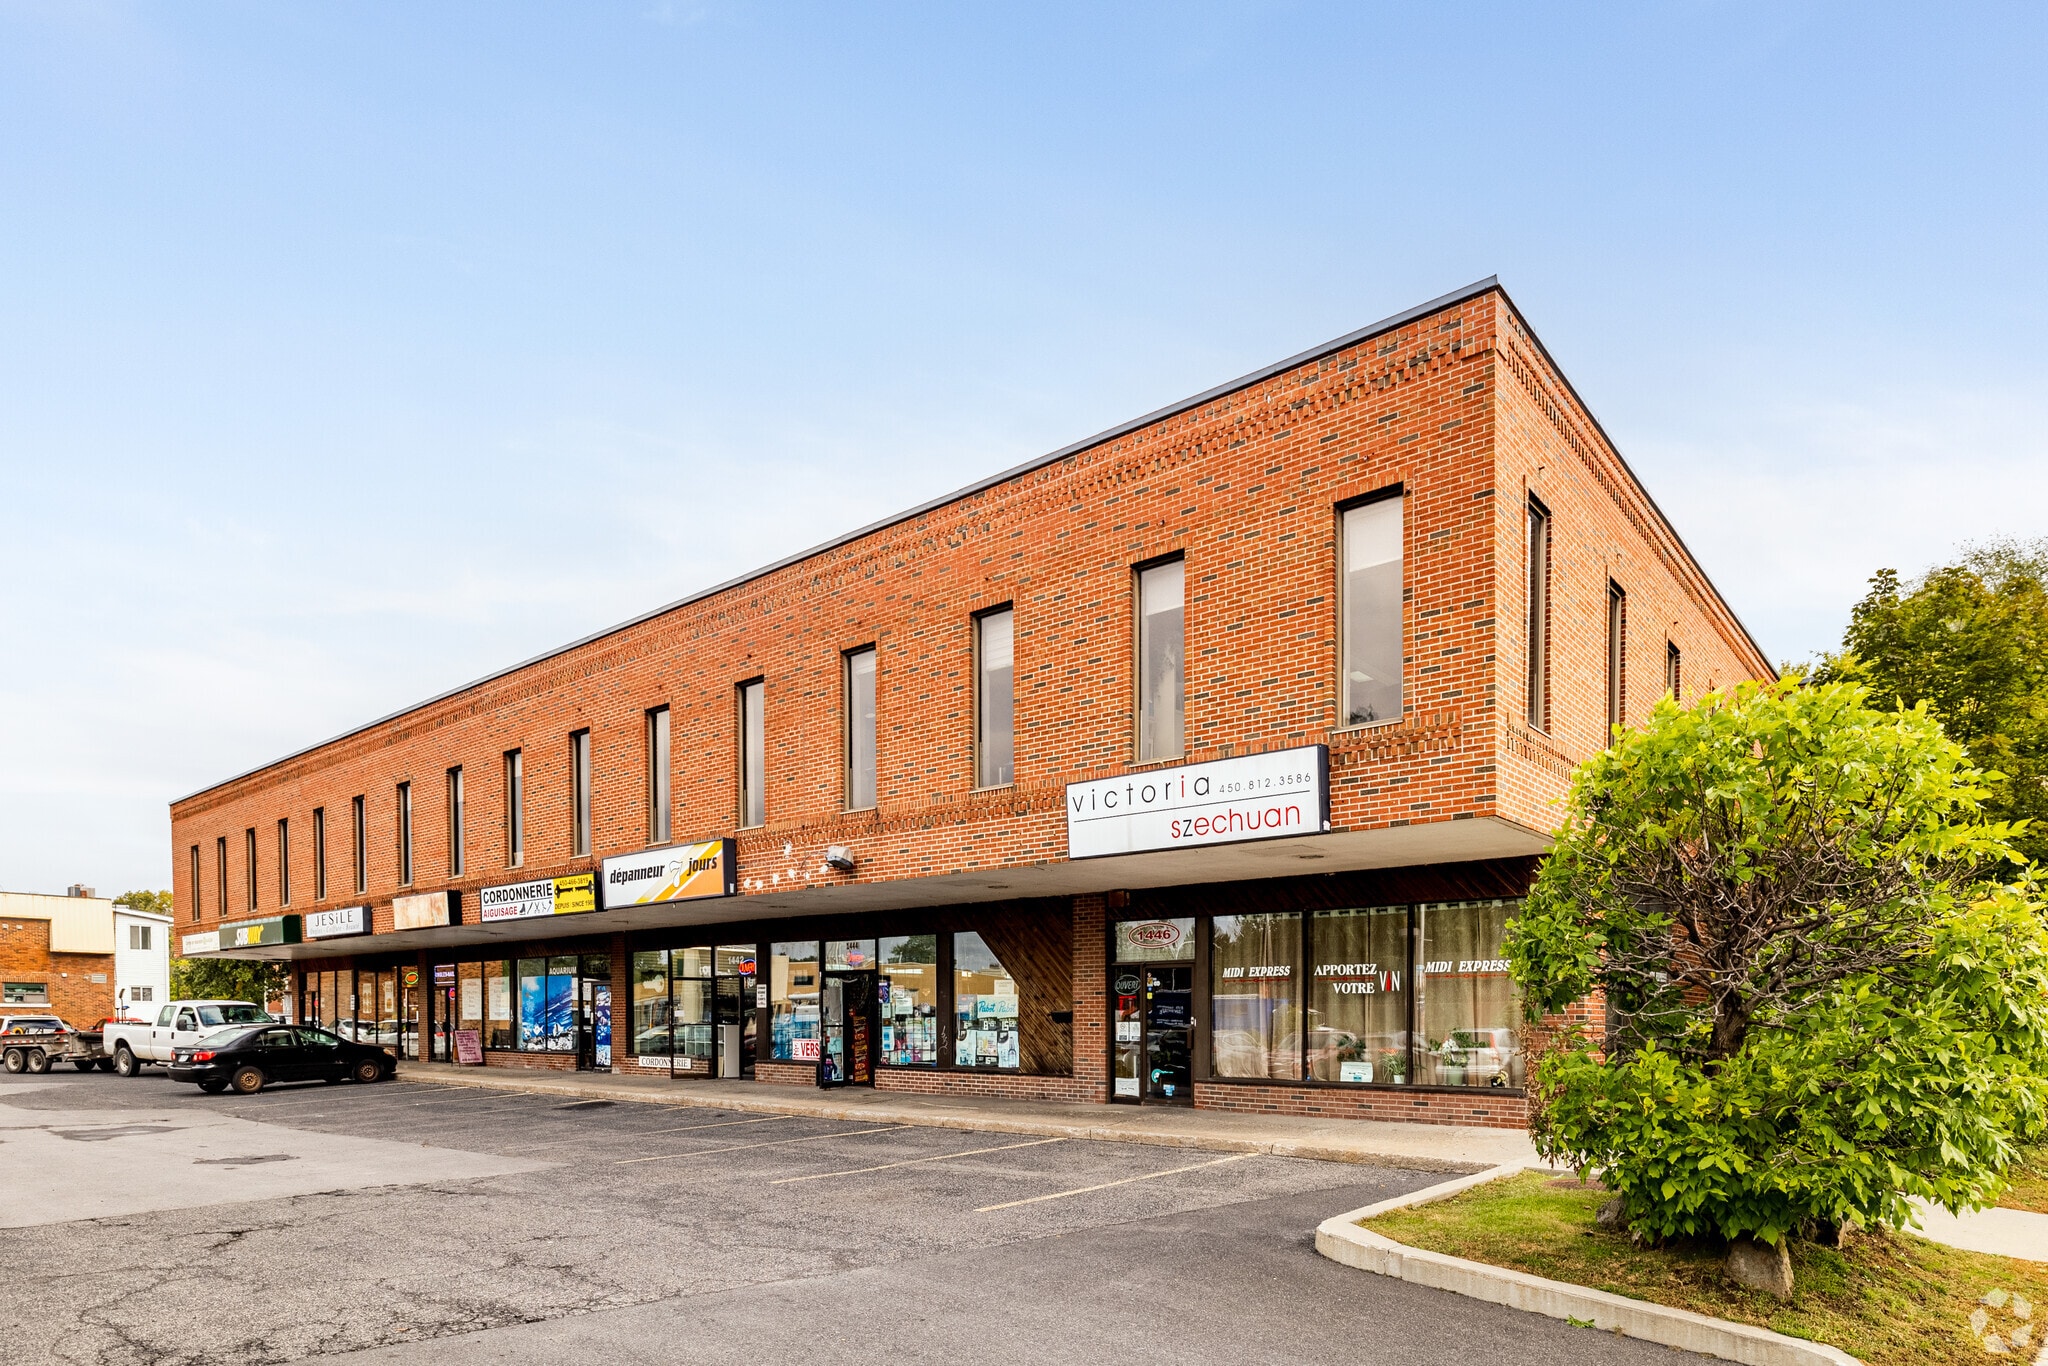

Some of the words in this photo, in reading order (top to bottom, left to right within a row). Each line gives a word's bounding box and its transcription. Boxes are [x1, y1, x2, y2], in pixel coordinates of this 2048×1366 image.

[1072, 775, 1210, 812] victoria
[1219, 772, 1312, 794] 450.812.3586
[1171, 804, 1301, 839] szechuan
[609, 864, 665, 885] dépanneur
[668, 860, 683, 888] 7
[686, 856, 718, 876] jours
[483, 882, 553, 904] CORDONNERIE
[483, 906, 518, 918] AIGUISAGE
[554, 902, 570, 910] DEPUIS
[235, 924, 264, 946] SUBWAY
[1137, 929, 1171, 941] 1446
[548, 966, 577, 975] AQUARIUM
[1222, 967, 1245, 978] MIDI
[1248, 965, 1291, 977] EXPRESS
[1313, 963, 1377, 976] APPORTEZ
[1424, 961, 1454, 973] MIDI
[1457, 959, 1512, 973] EXPRESS
[1116, 980, 1139, 990] OUVERT
[1332, 982, 1375, 995] VOTRE
[978, 1000, 996, 1014] Pabst
[800, 1042, 820, 1057] VERS
[641, 1057, 688, 1068] CORDONNERIE
